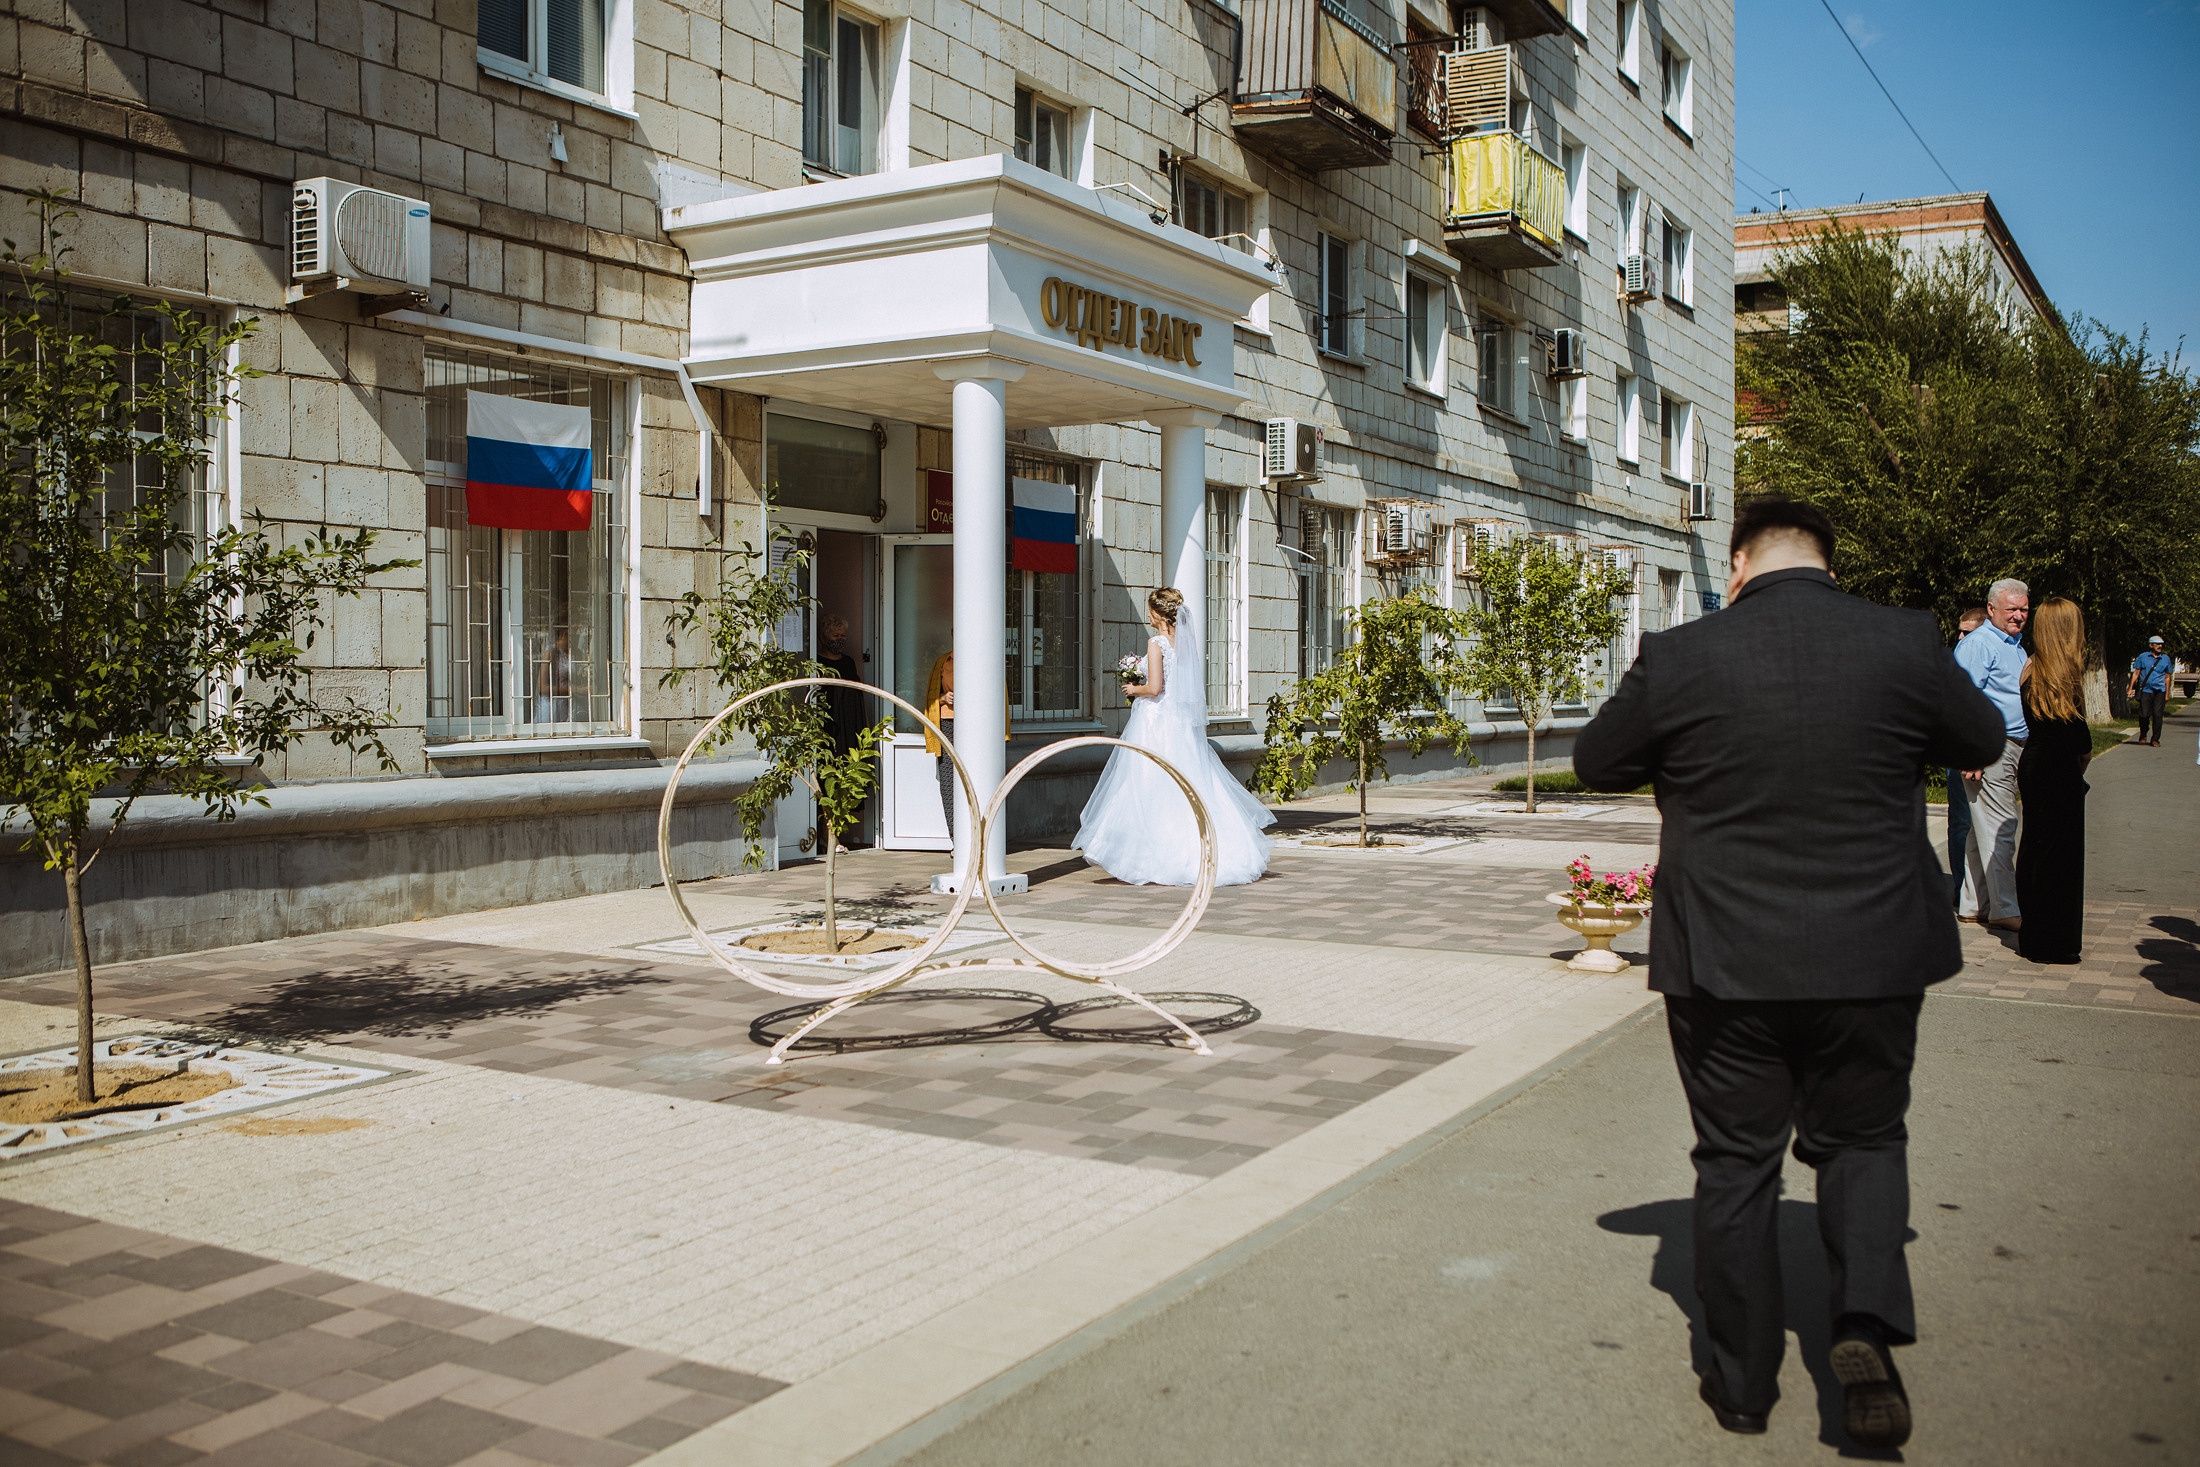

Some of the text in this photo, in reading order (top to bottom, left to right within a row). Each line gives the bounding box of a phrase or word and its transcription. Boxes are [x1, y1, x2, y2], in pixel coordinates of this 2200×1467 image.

[1041, 276, 1203, 367] ОТДЕЛ ЗАГС
[931, 507, 953, 525] Отде
